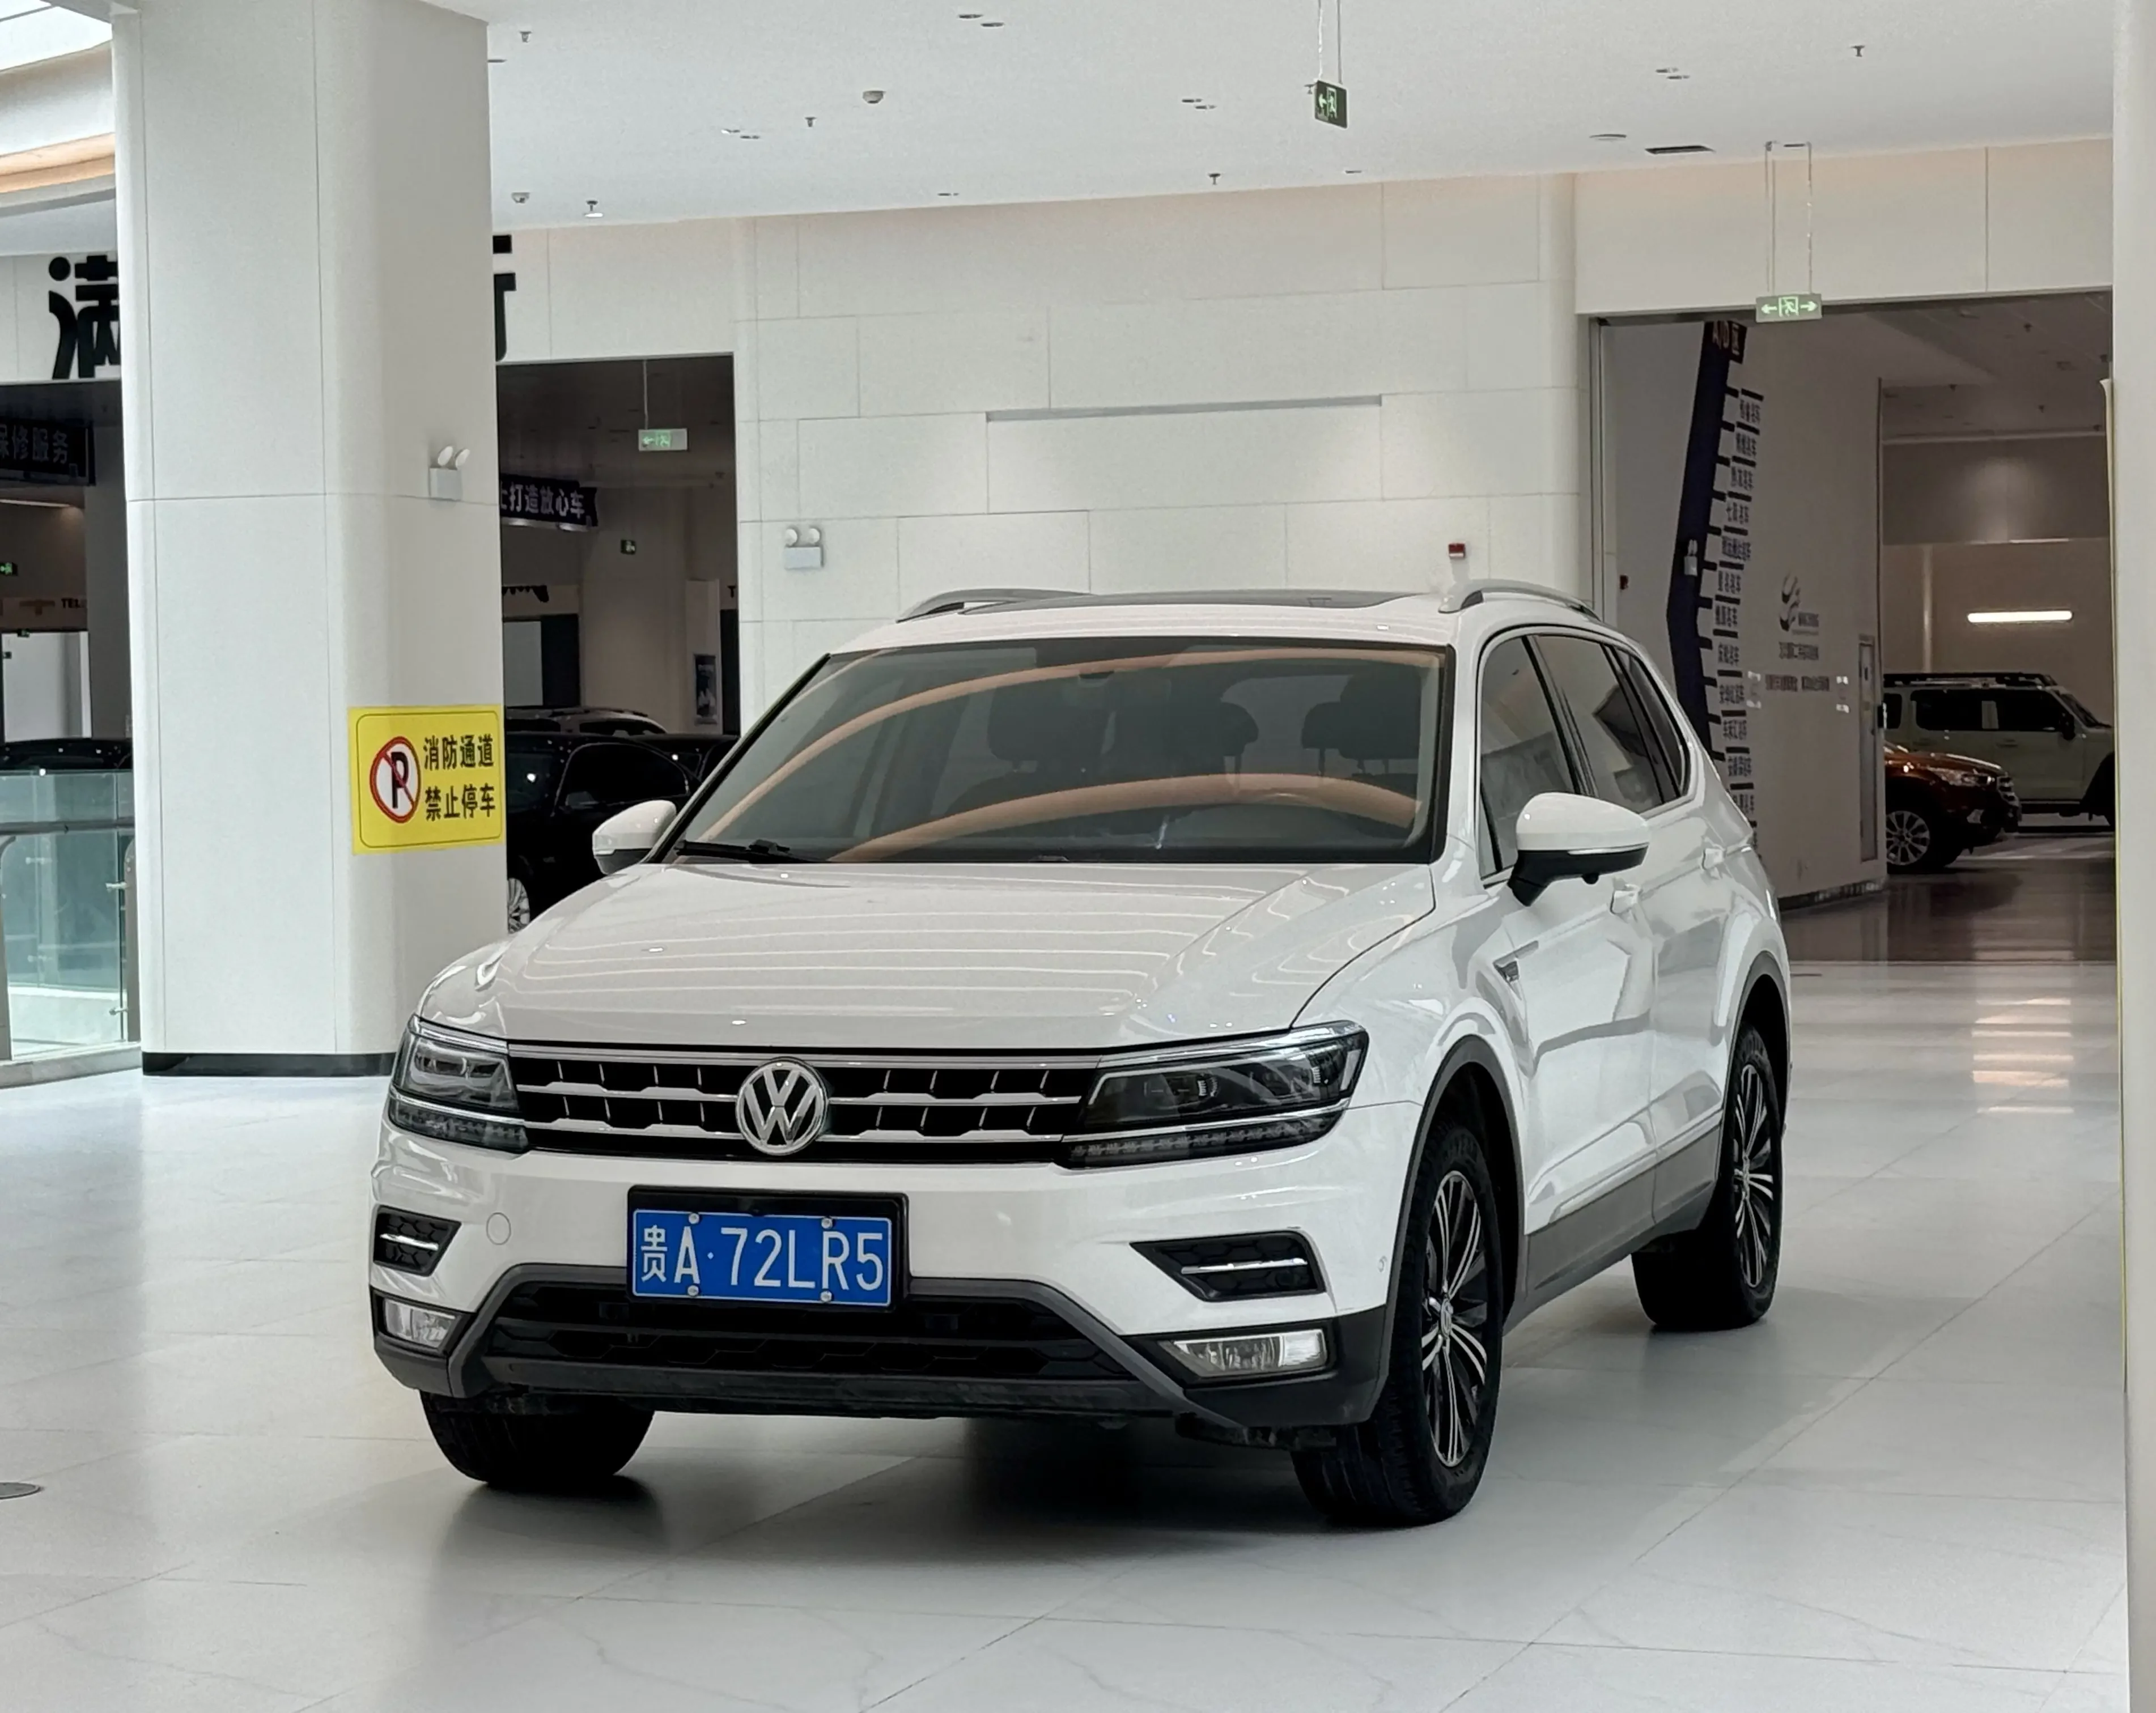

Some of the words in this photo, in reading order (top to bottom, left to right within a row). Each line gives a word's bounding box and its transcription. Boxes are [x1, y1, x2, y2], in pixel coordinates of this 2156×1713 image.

[423, 734, 494, 771] 消防通道
[425, 783, 495, 822] 禁止停车
